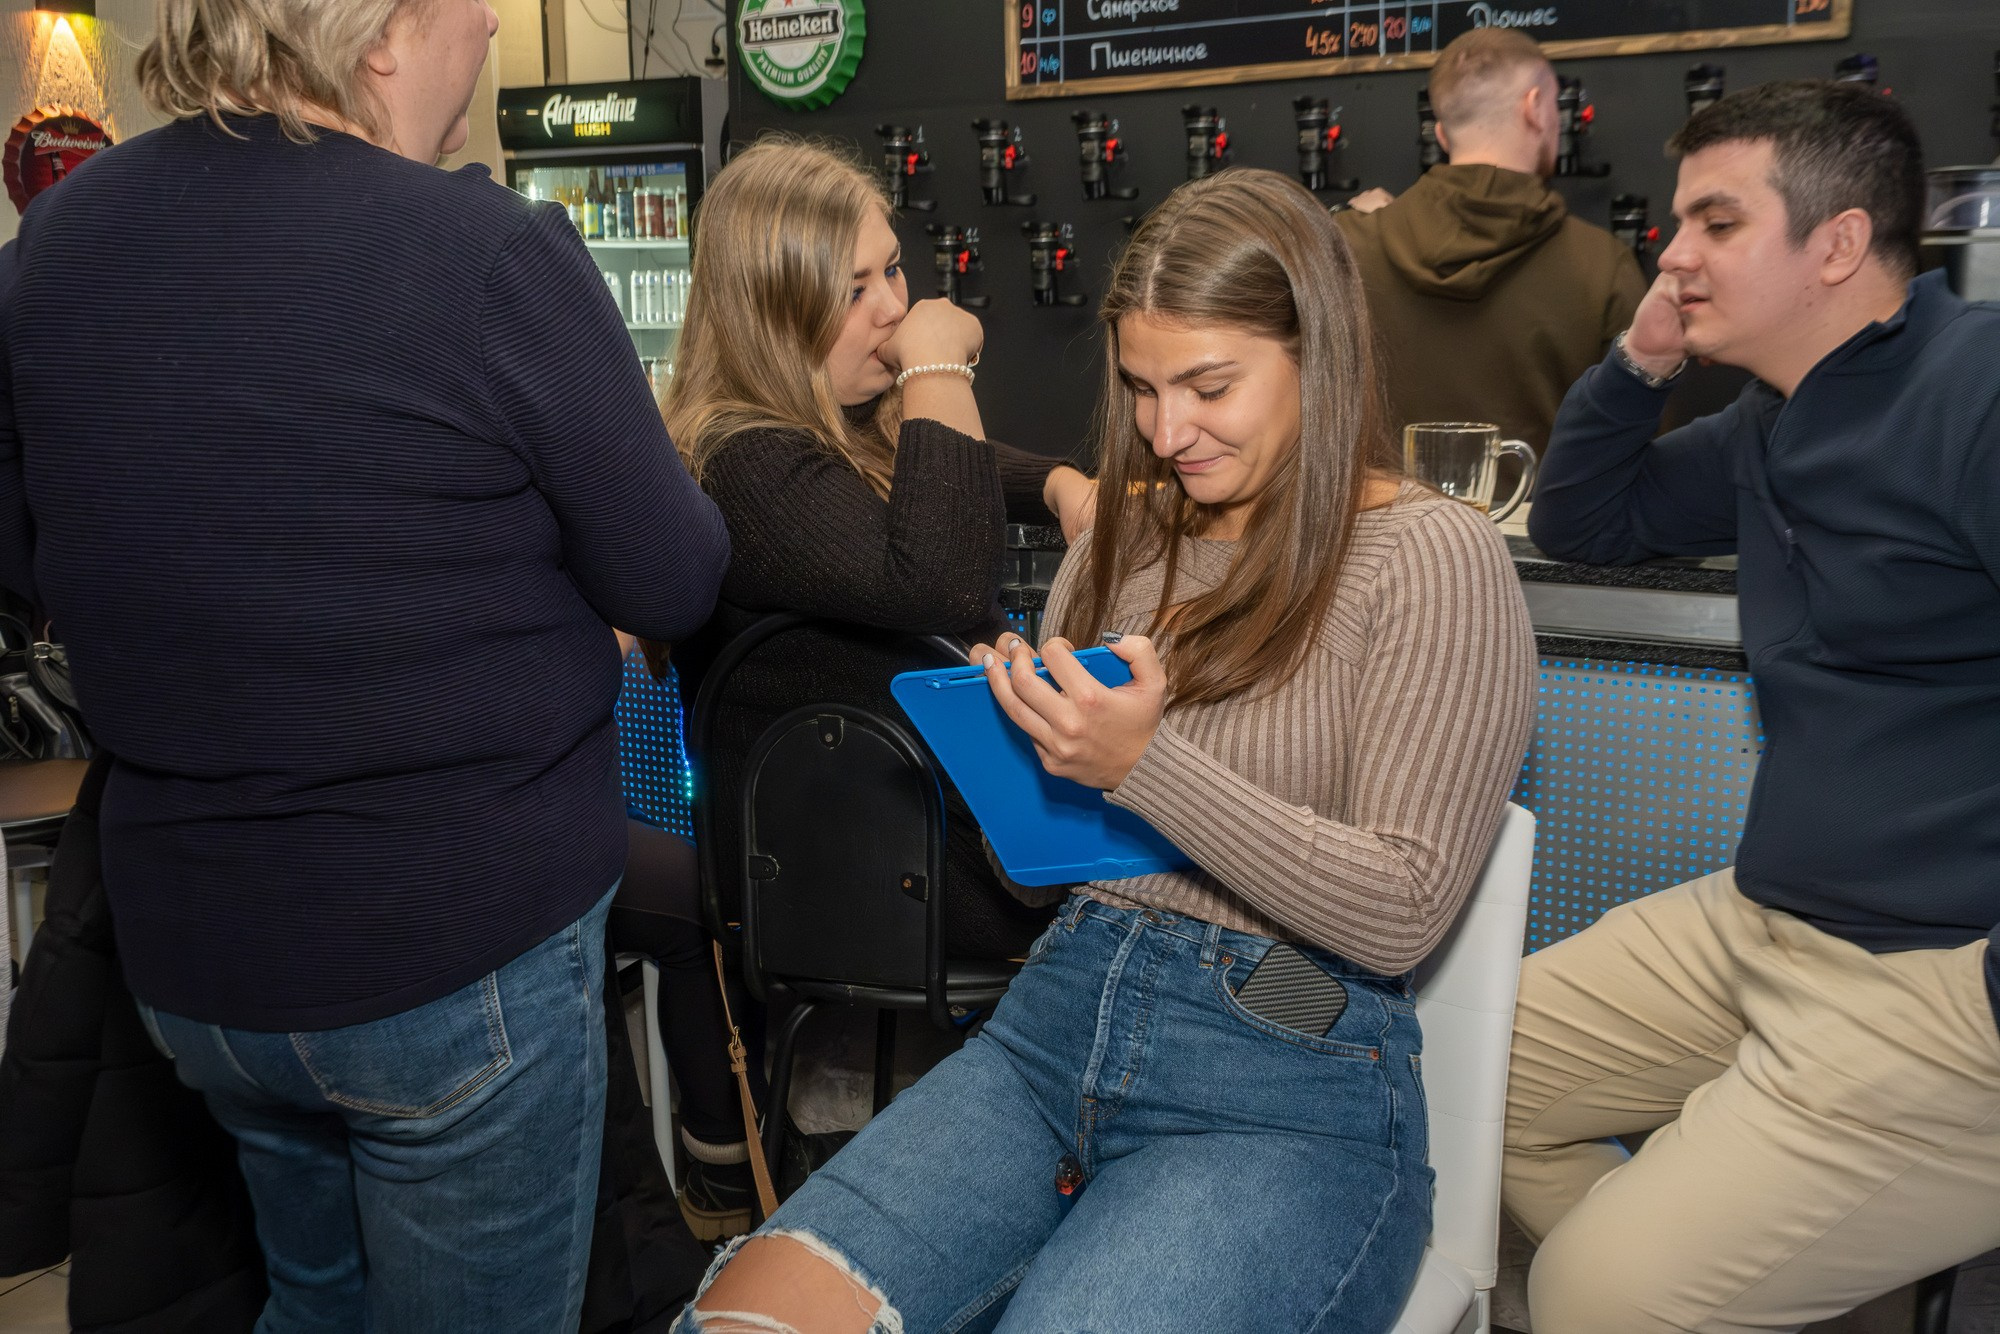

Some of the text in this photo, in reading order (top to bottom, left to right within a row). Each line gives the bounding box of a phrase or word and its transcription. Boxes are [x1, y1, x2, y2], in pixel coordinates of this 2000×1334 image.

[748, 10, 835, 42] Heineken
[1022, 3, 1034, 28] 9
[1384, 16, 1406, 39] 20
[1467, 2, 1558, 29] Дюшес
[757, 48, 828, 84] PREMIUM QUALITY
[1020, 51, 1037, 75] 10
[1090, 41, 1208, 71] Пшеничное
[543, 92, 638, 138] Adrenaline
[31, 130, 106, 151] Budweiser
[574, 122, 611, 137] RUSH
[916, 124, 925, 144] 1
[1013, 125, 1023, 143] 2
[1061, 222, 1075, 239] 12
